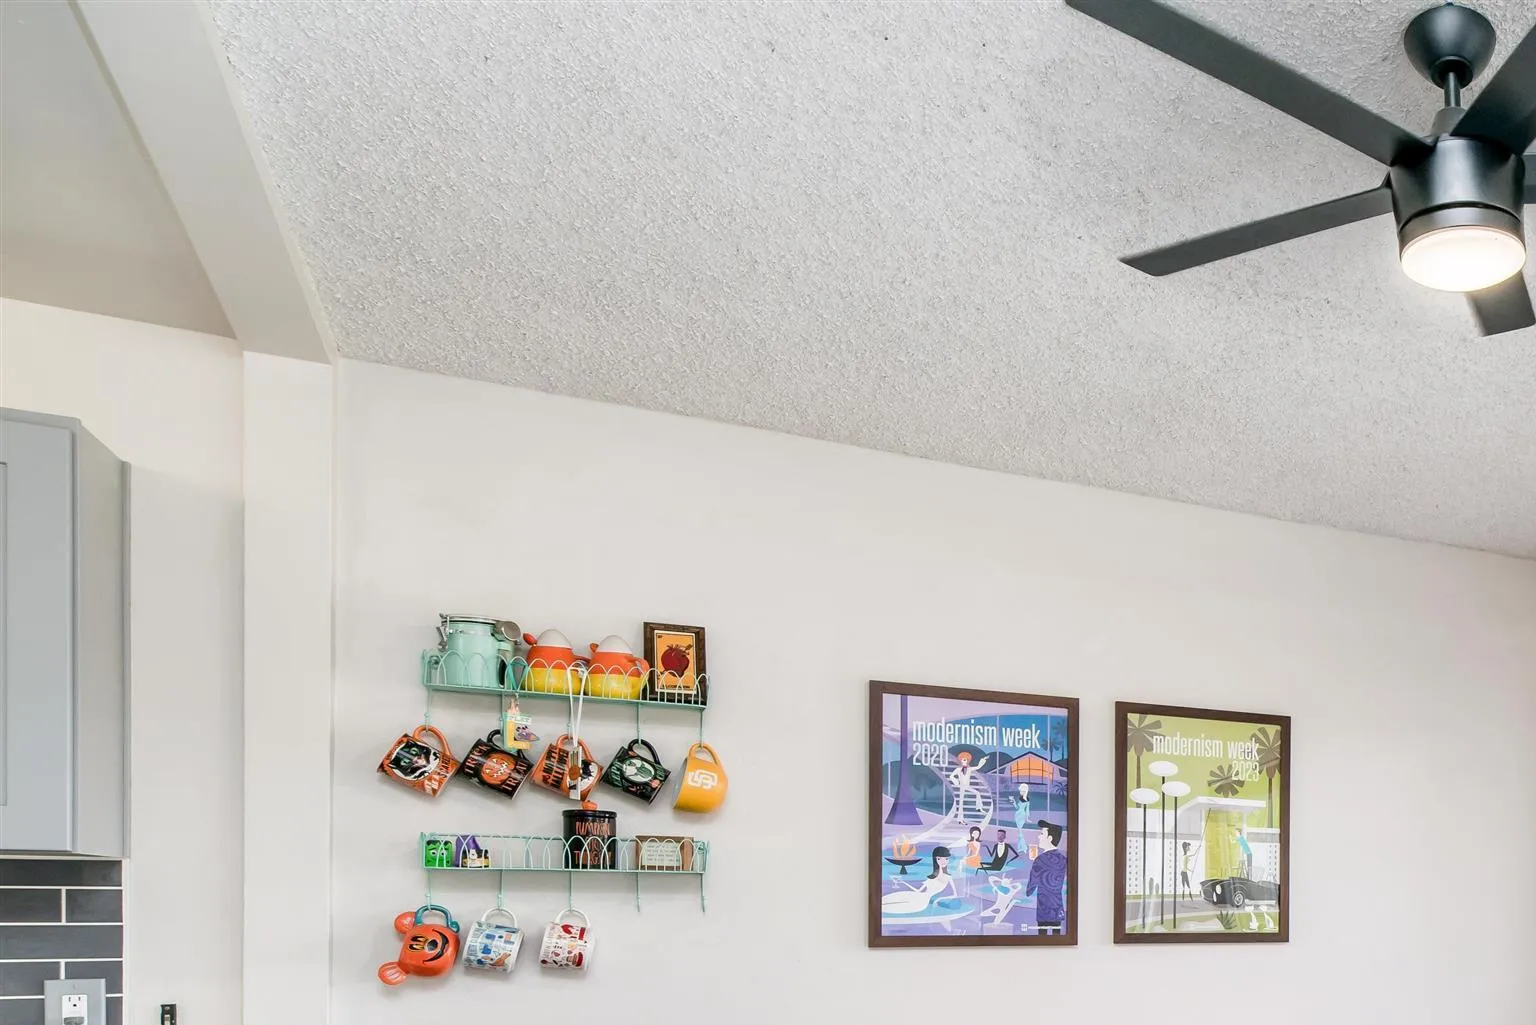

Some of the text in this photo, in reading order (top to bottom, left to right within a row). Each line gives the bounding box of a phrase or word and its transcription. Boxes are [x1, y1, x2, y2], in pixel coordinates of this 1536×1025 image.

[912, 717, 1041, 749] modernism week
[1152, 732, 1259, 761] modernism week
[912, 742, 949, 767] 2020
[1231, 760, 1260, 782] 2023
